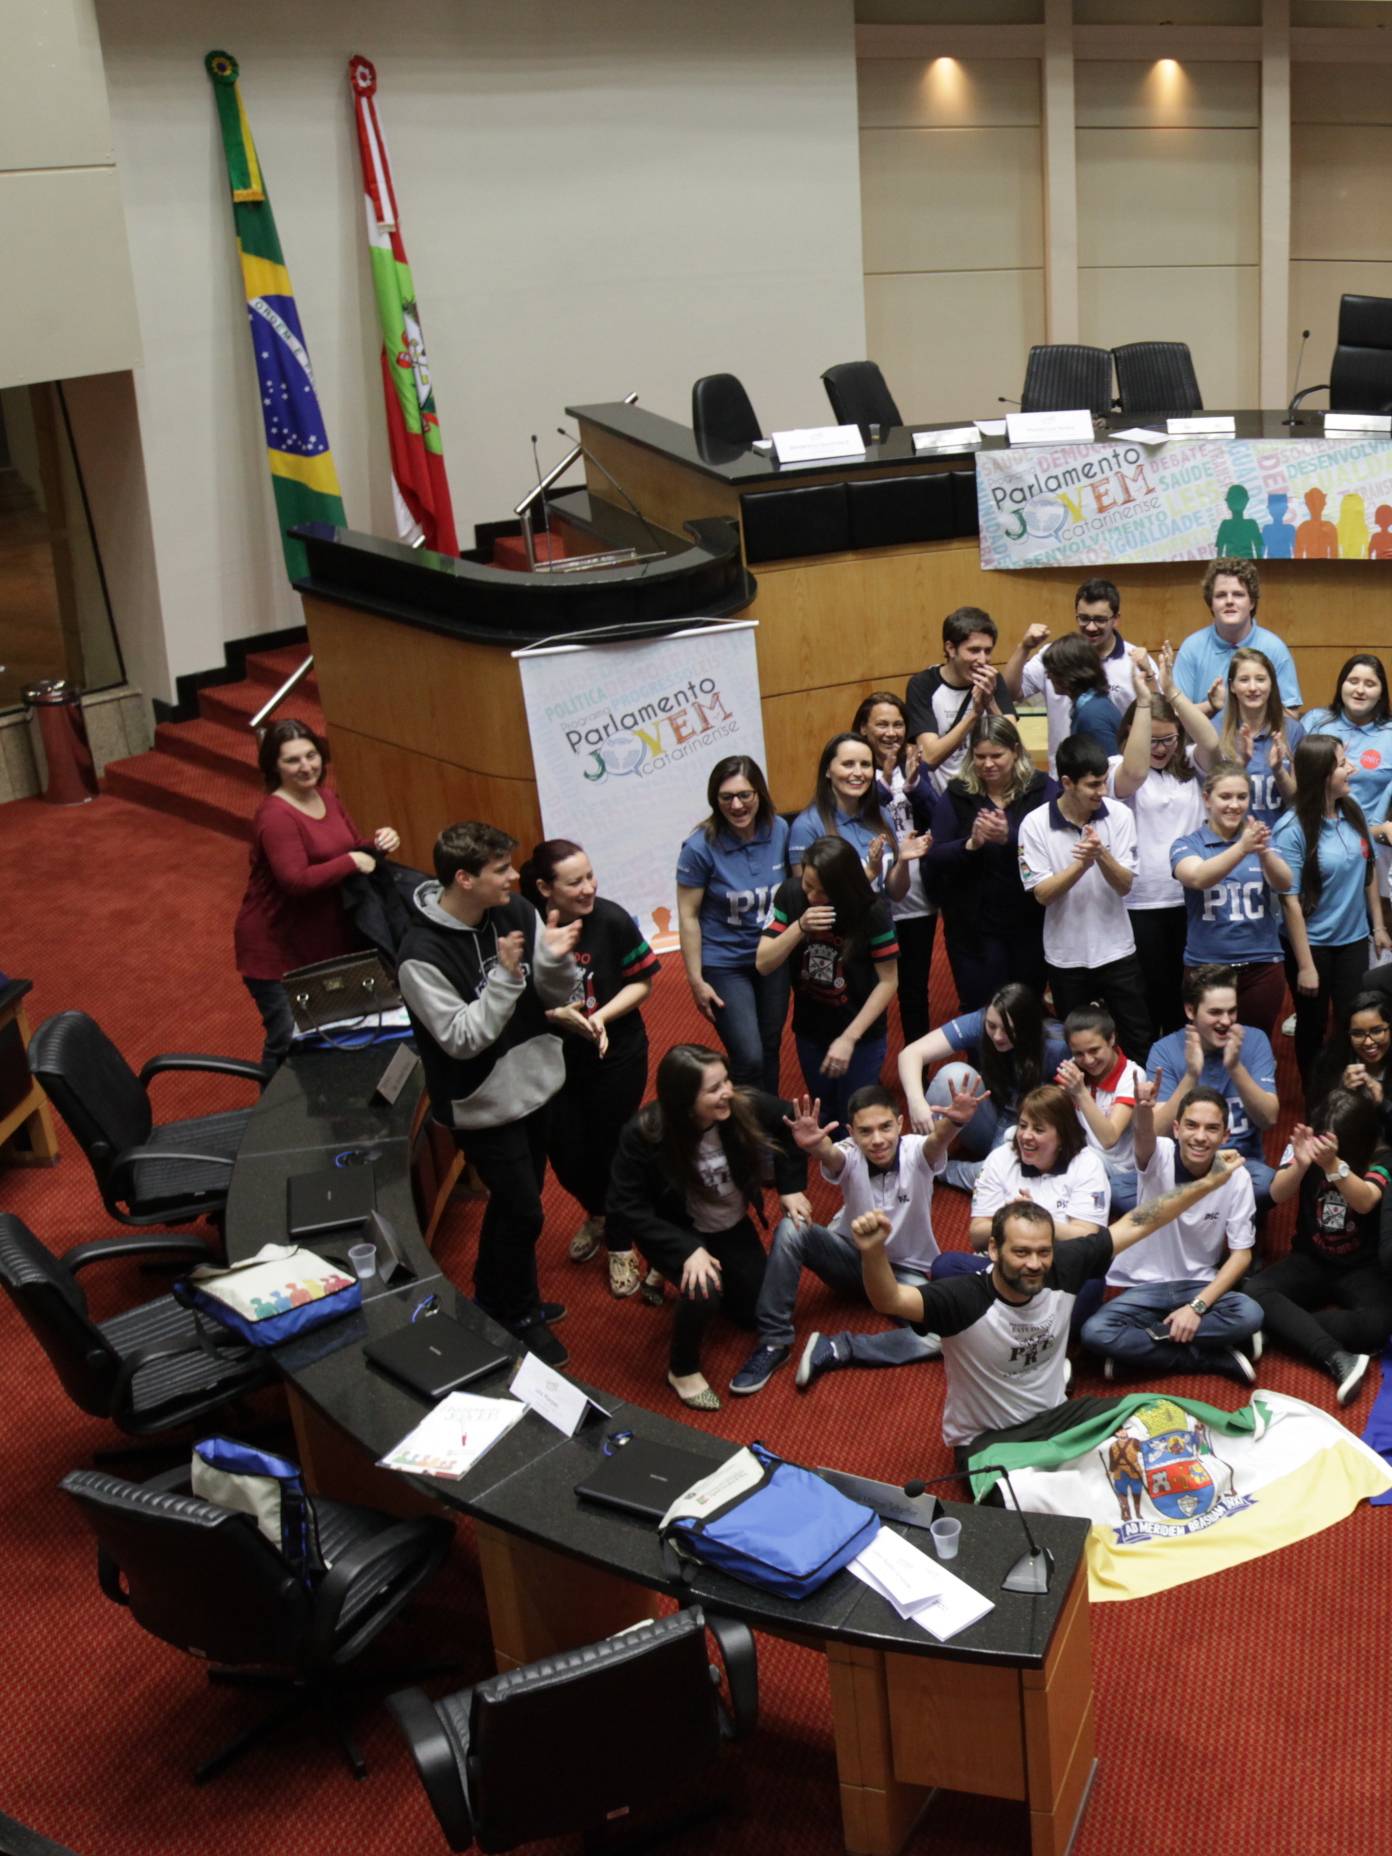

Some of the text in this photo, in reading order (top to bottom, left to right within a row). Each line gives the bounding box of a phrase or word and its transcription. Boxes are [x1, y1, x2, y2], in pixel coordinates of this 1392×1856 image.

[1149, 443, 1209, 474] DEBATE
[1158, 460, 1214, 492] SAÚDE
[991, 447, 1140, 511] Parlamento
[1164, 479, 1221, 518] LEIS
[1060, 496, 1163, 542] catarinense
[1107, 510, 1206, 557] IGUALDADE
[544, 686, 608, 723] POLÍTICA
[560, 706, 612, 732] Programa
[565, 677, 716, 754] Parlamento
[641, 719, 741, 776] catarinense
[1251, 774, 1281, 811] IC
[1201, 882, 1264, 921] PIC
[1204, 1210, 1220, 1221] PSC
[888, 1502, 918, 1518] Scheffer
[1125, 1522, 1139, 1536] AD
[1140, 1521, 1186, 1537] MERIDIEM
